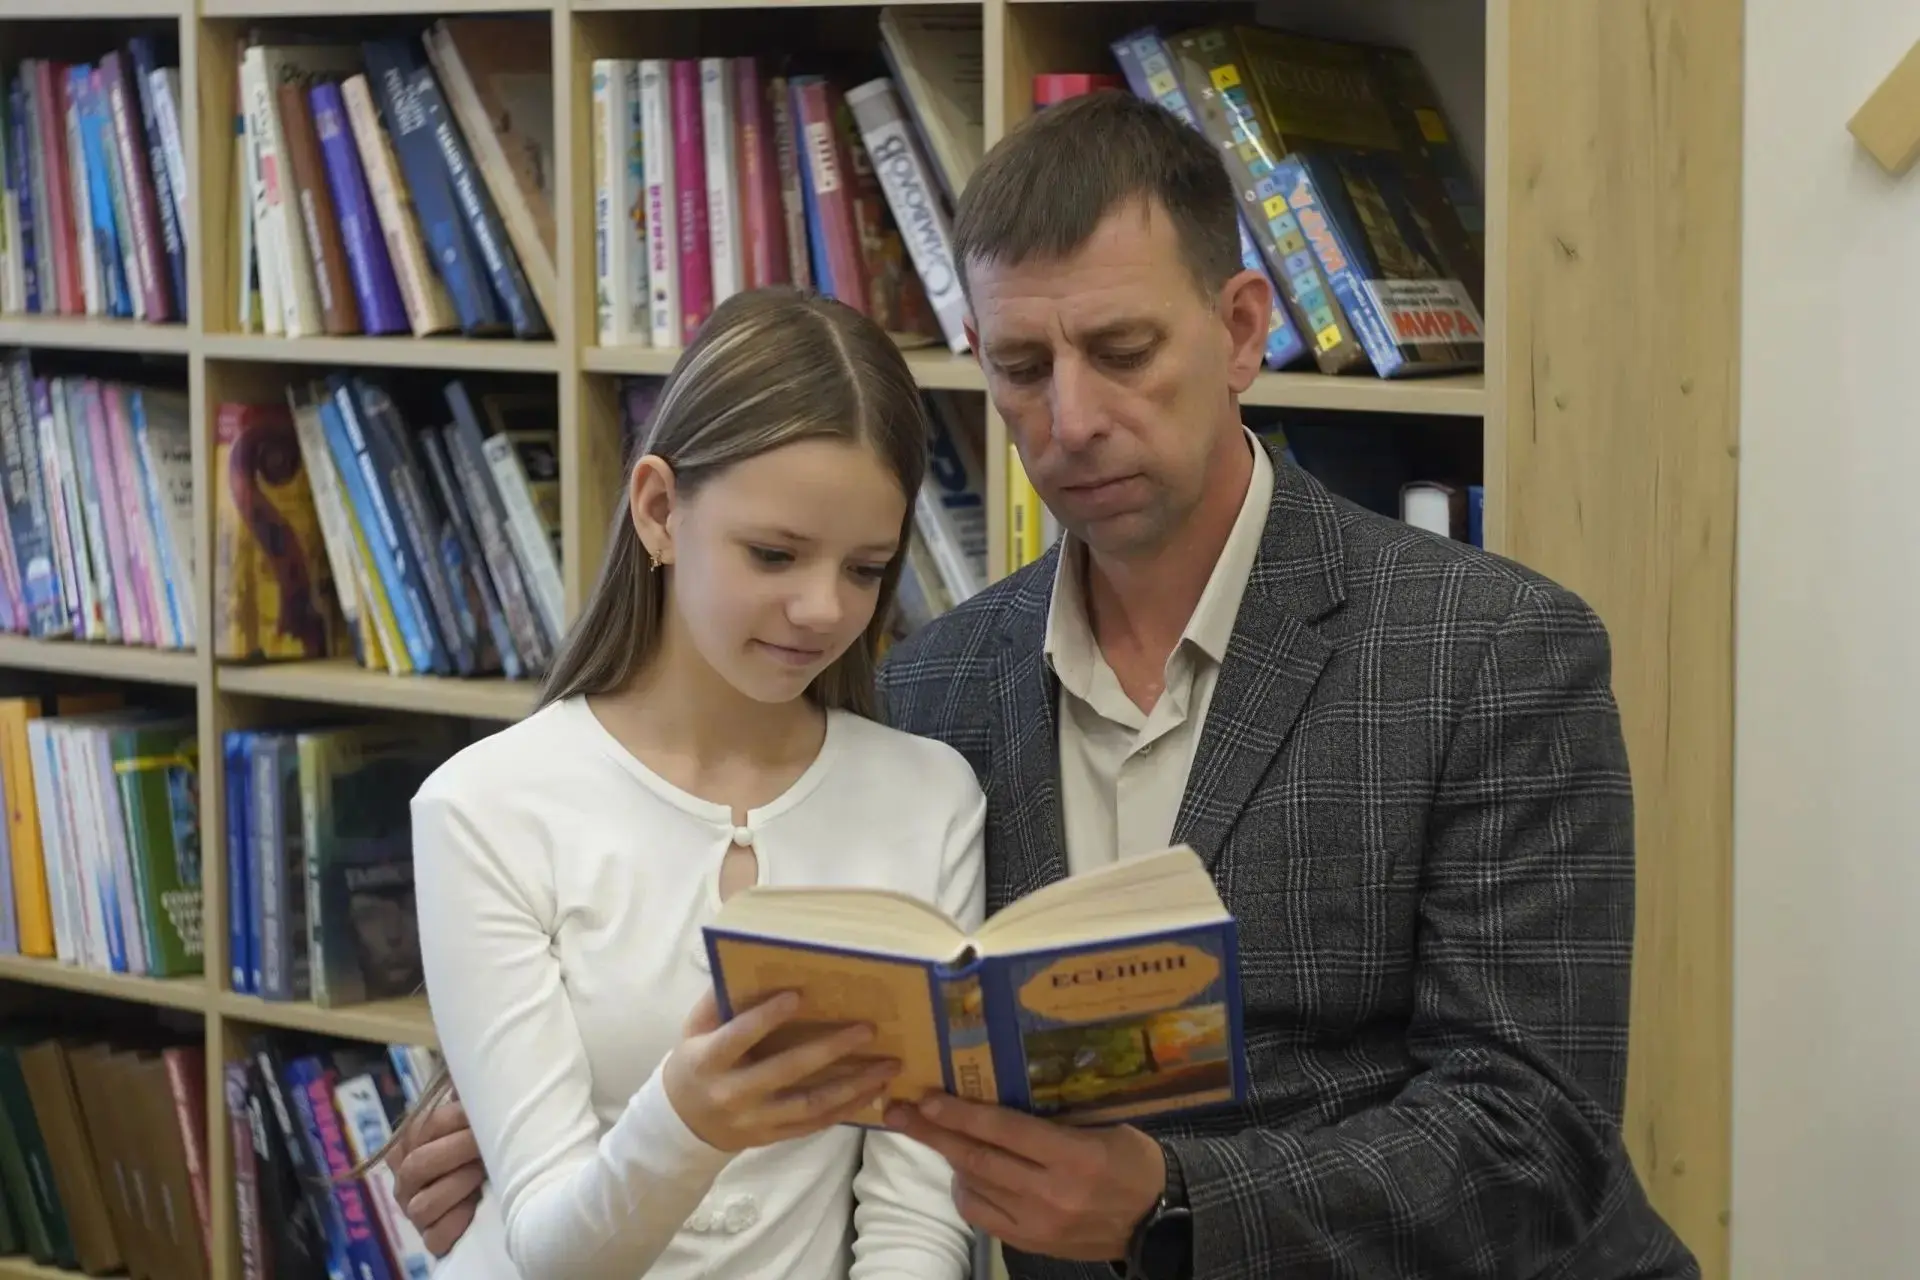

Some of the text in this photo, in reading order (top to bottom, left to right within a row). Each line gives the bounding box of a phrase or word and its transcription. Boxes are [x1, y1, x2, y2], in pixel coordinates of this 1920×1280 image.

[1288, 182, 1348, 276] МИРА
[1391, 309, 1479, 338] МИРА
[1052, 956, 1187, 989] ЕСЕНИН
